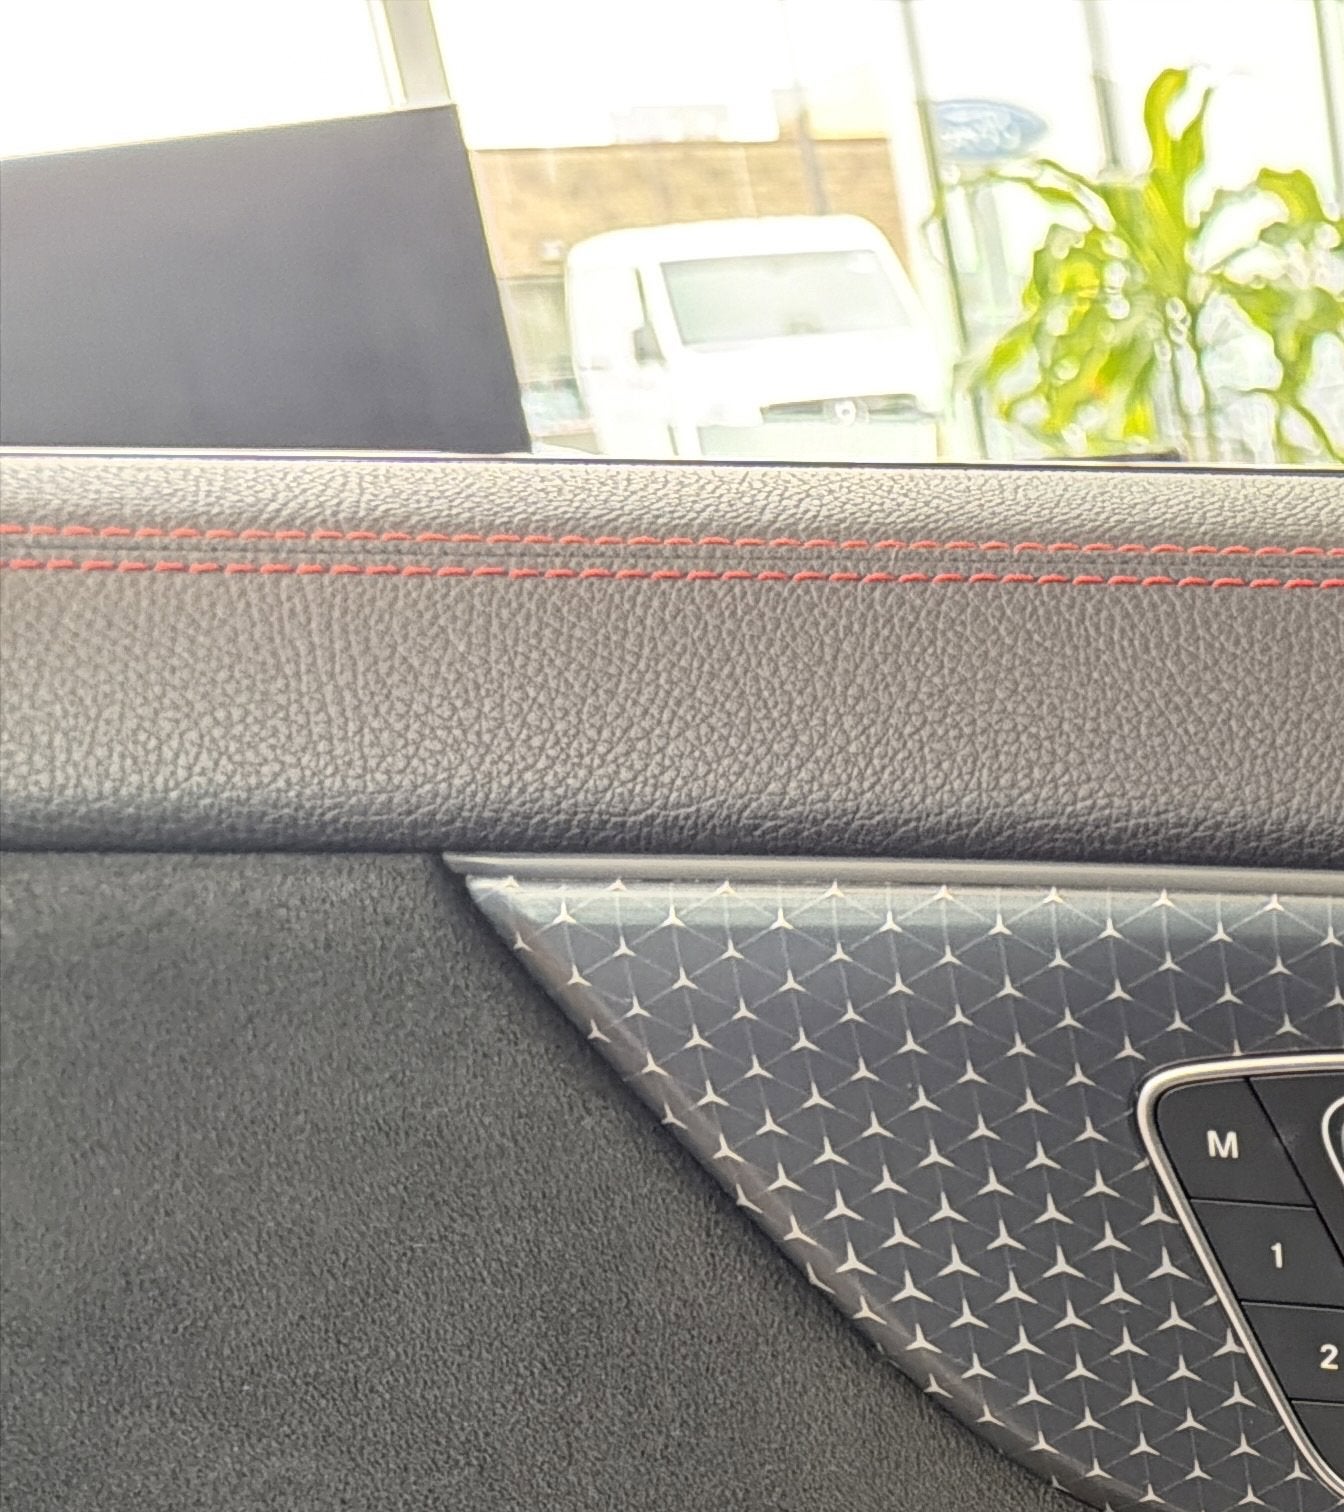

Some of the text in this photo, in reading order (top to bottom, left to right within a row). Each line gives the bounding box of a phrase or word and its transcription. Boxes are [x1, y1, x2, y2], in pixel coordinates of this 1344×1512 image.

[1206, 1130, 1239, 1159] M
[1271, 1242, 1283, 1268] 1
[1320, 1344, 1339, 1370] 2
